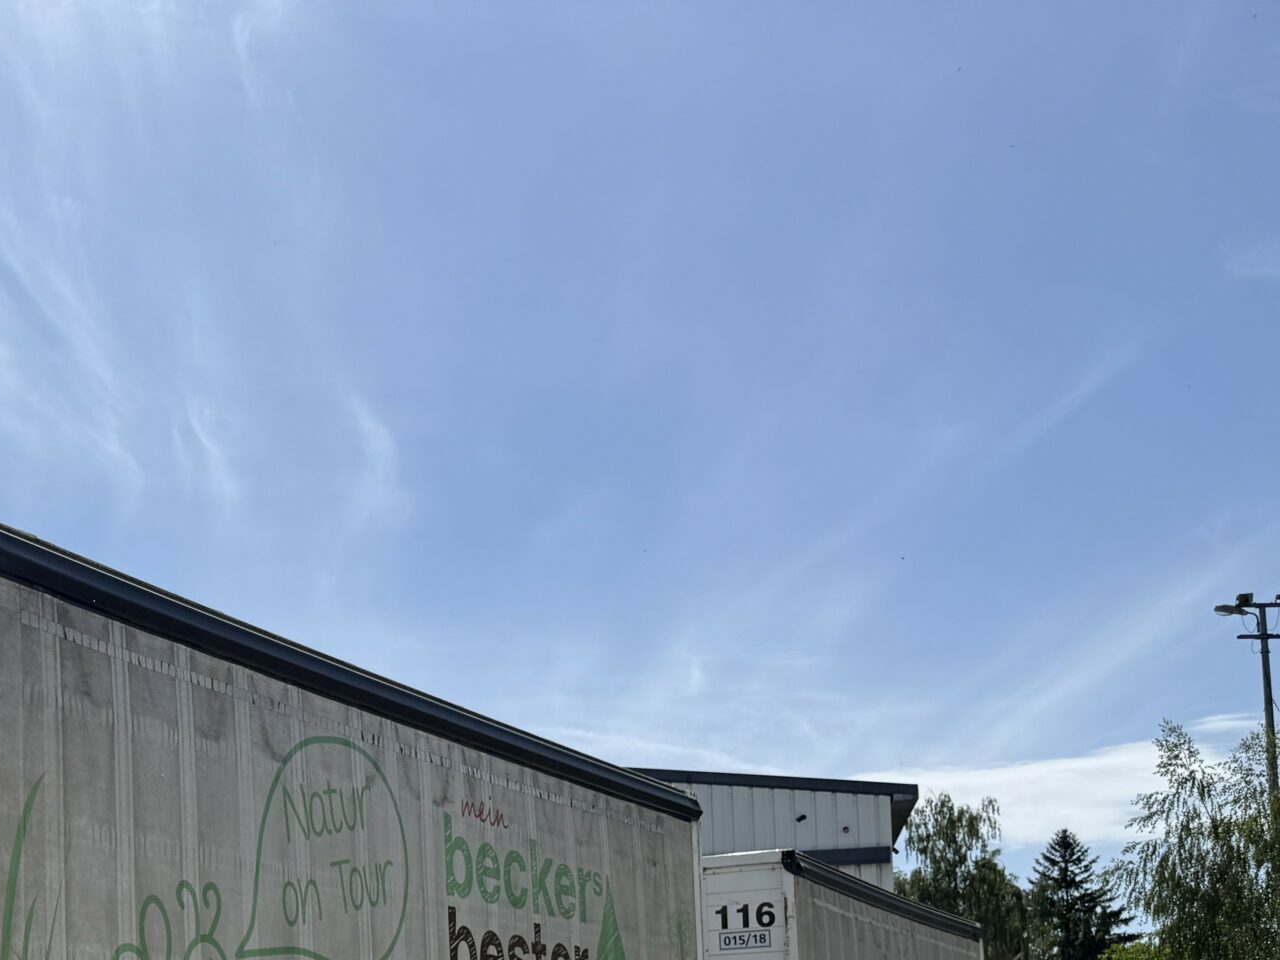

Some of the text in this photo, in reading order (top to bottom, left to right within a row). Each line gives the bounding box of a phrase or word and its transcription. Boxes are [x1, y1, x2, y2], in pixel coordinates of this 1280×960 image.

[282, 779, 371, 844] Natur
[461, 796, 509, 829] mein
[443, 811, 603, 924] beckers
[282, 859, 394, 928] on Tour
[714, 901, 776, 931] 116
[723, 933, 767, 947] 015/18
